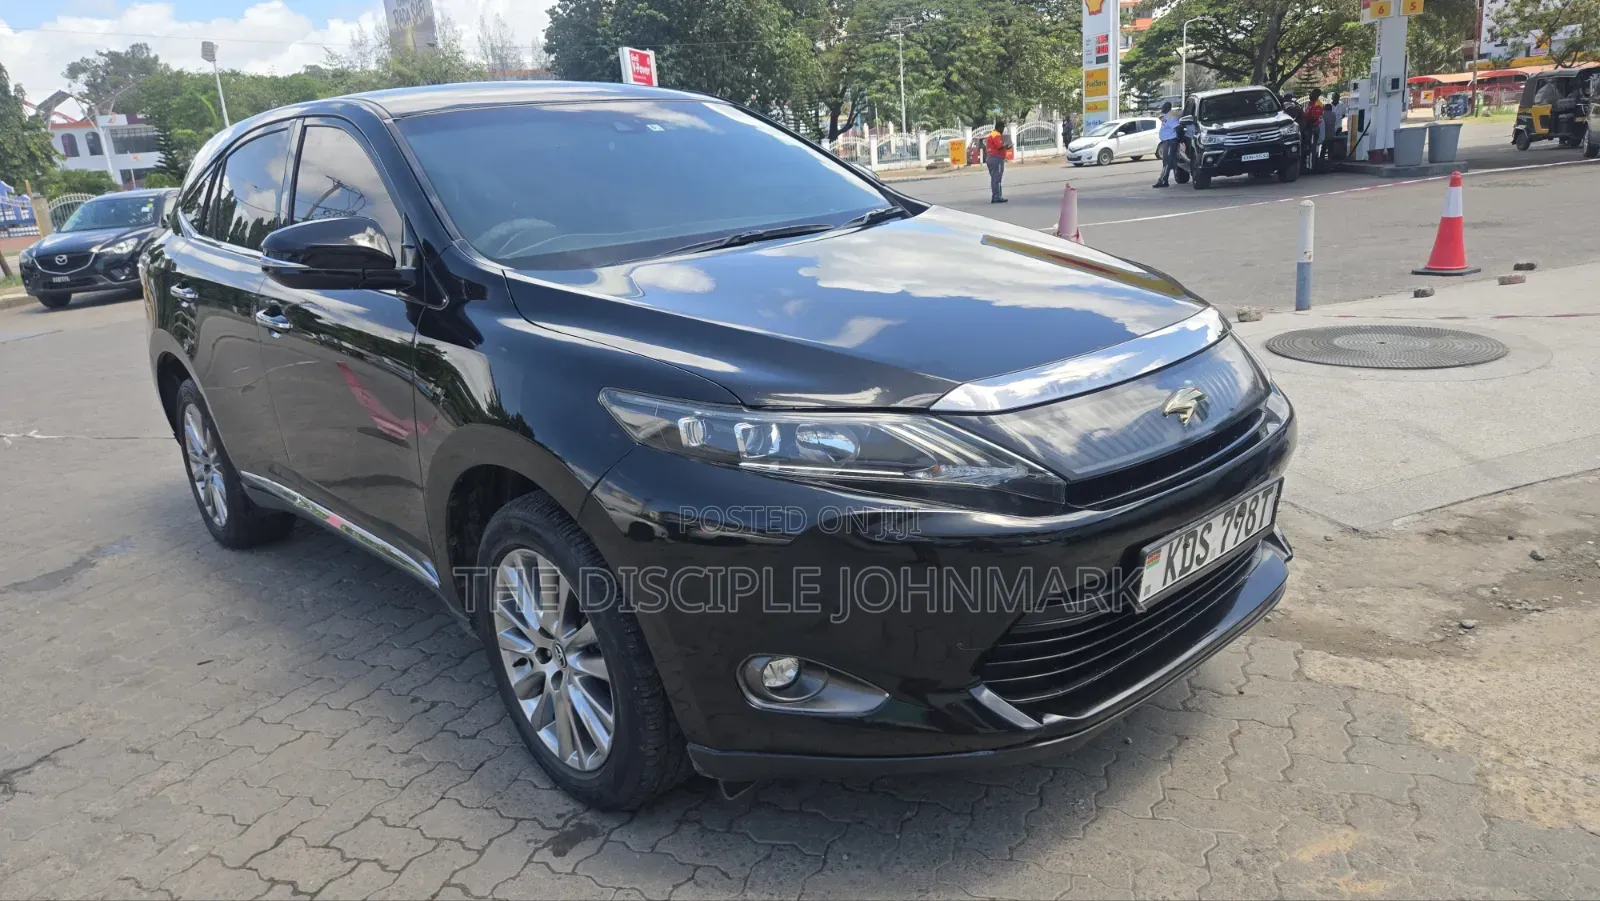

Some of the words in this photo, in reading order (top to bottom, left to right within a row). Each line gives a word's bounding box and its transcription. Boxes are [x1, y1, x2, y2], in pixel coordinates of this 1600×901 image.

[1378, 6, 1384, 14] 6
[1086, 79, 1107, 88] FuelSave
[1162, 522, 1213, 587] KDS
[1220, 486, 1275, 554] 798T
